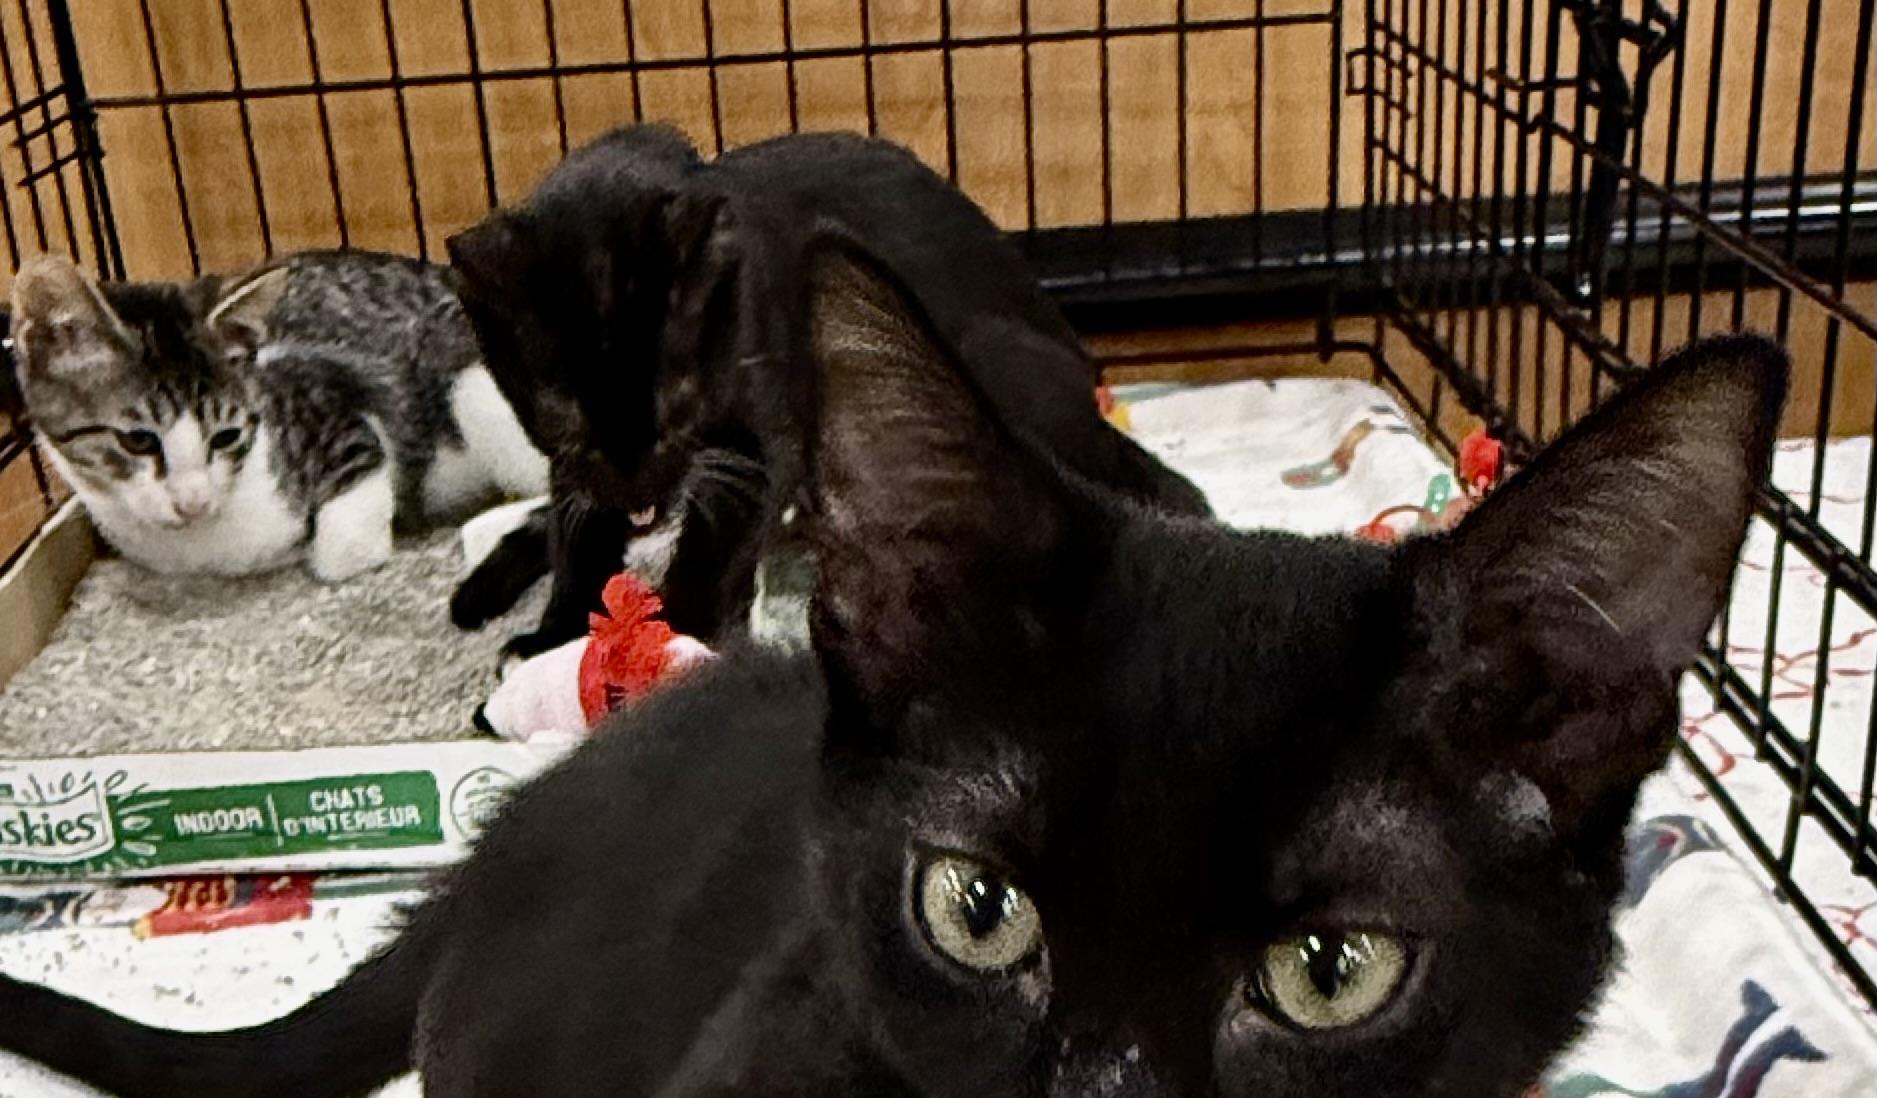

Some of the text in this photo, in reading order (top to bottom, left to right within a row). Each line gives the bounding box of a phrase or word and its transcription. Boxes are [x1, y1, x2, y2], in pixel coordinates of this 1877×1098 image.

[310, 784, 384, 812] CHATS
[0, 810, 96, 846] skies
[174, 807, 263, 835] INDOOR
